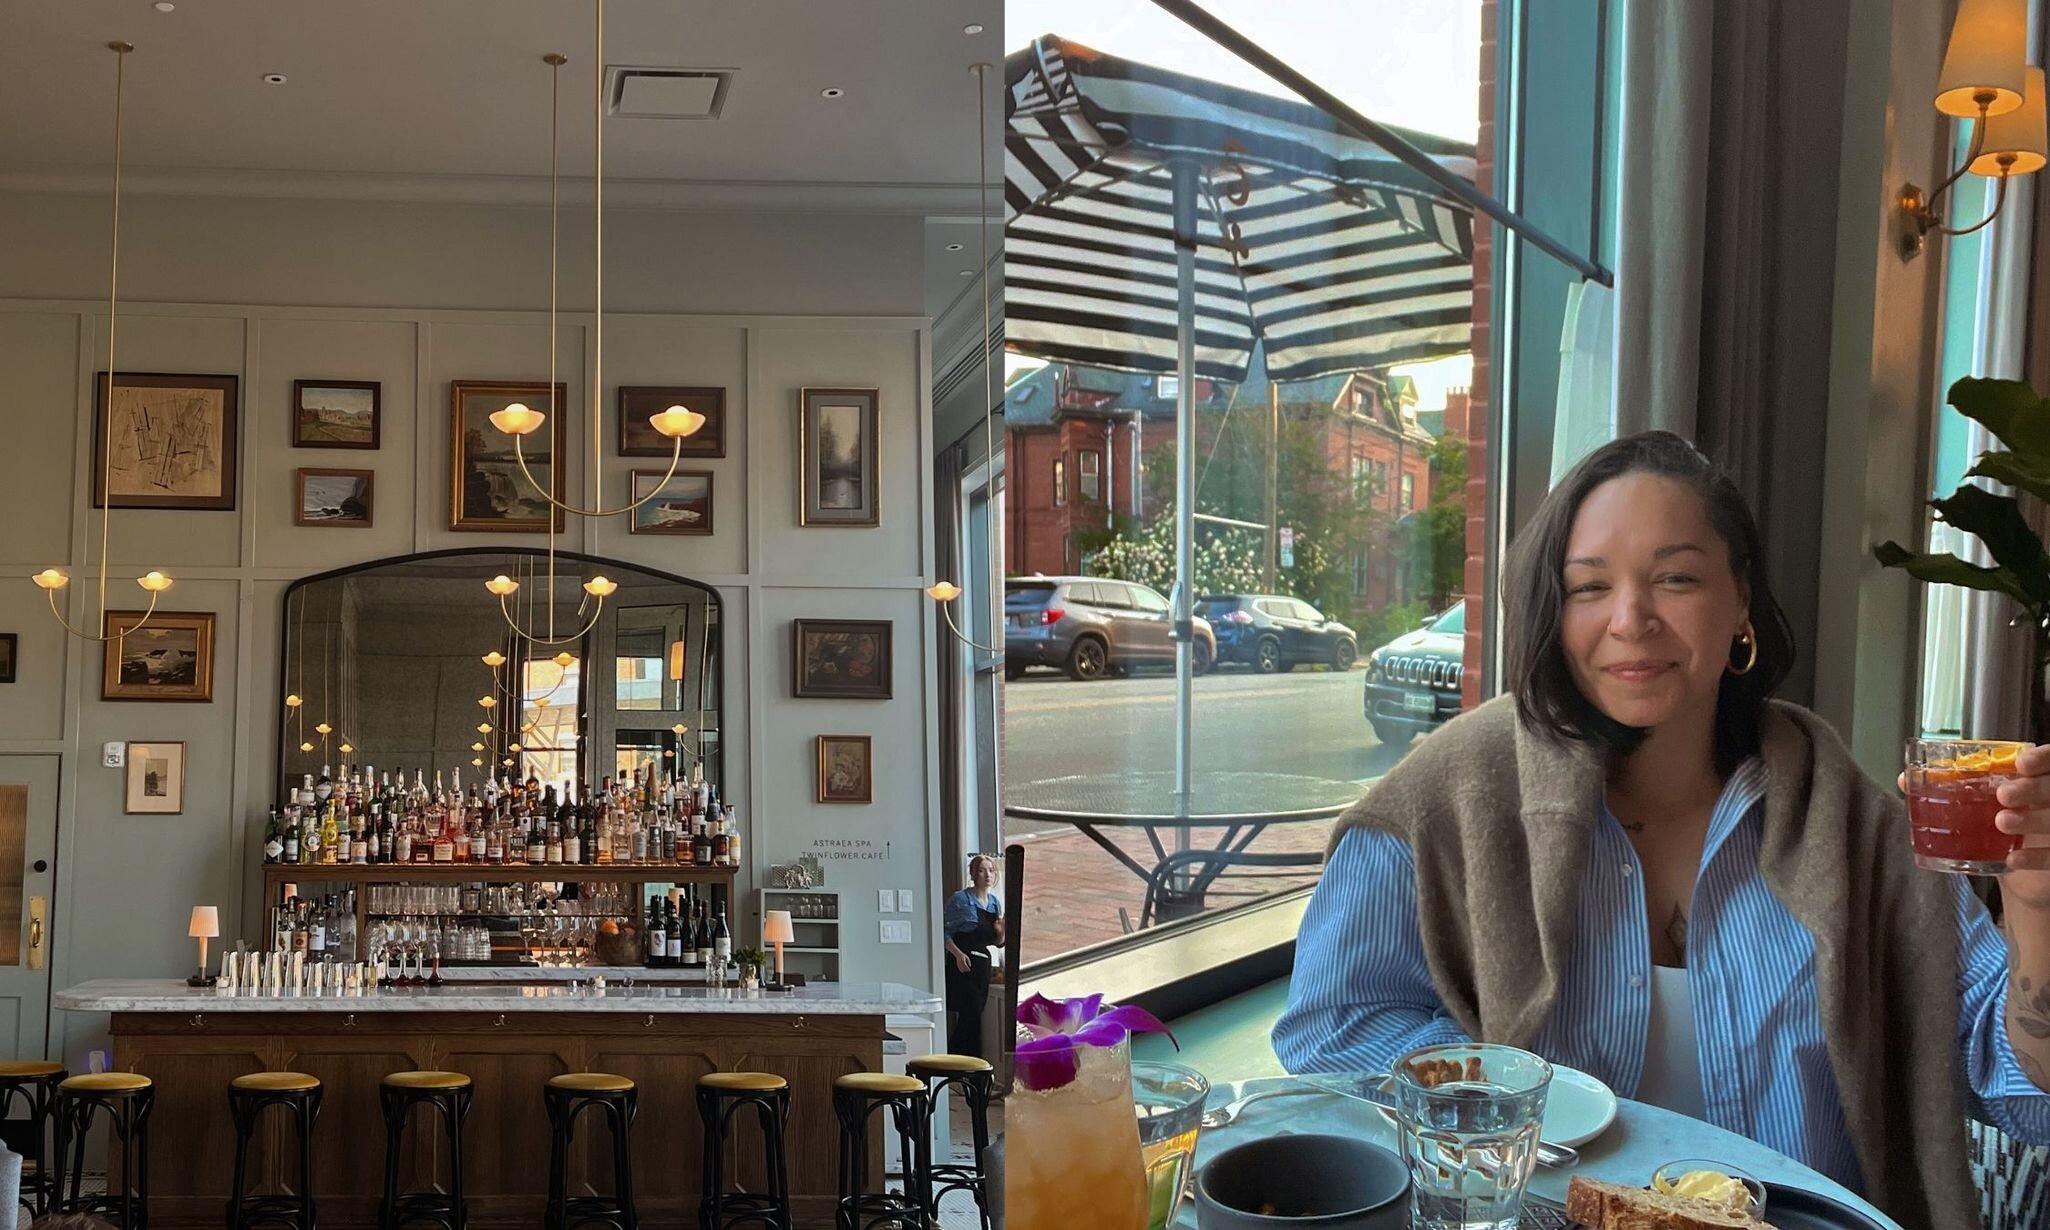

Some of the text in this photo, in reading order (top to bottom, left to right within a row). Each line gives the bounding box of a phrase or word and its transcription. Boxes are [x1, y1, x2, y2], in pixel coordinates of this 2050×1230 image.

[813, 840, 872, 848] ASTRAEA SPA
[801, 851, 859, 859] TWINFLOWER
